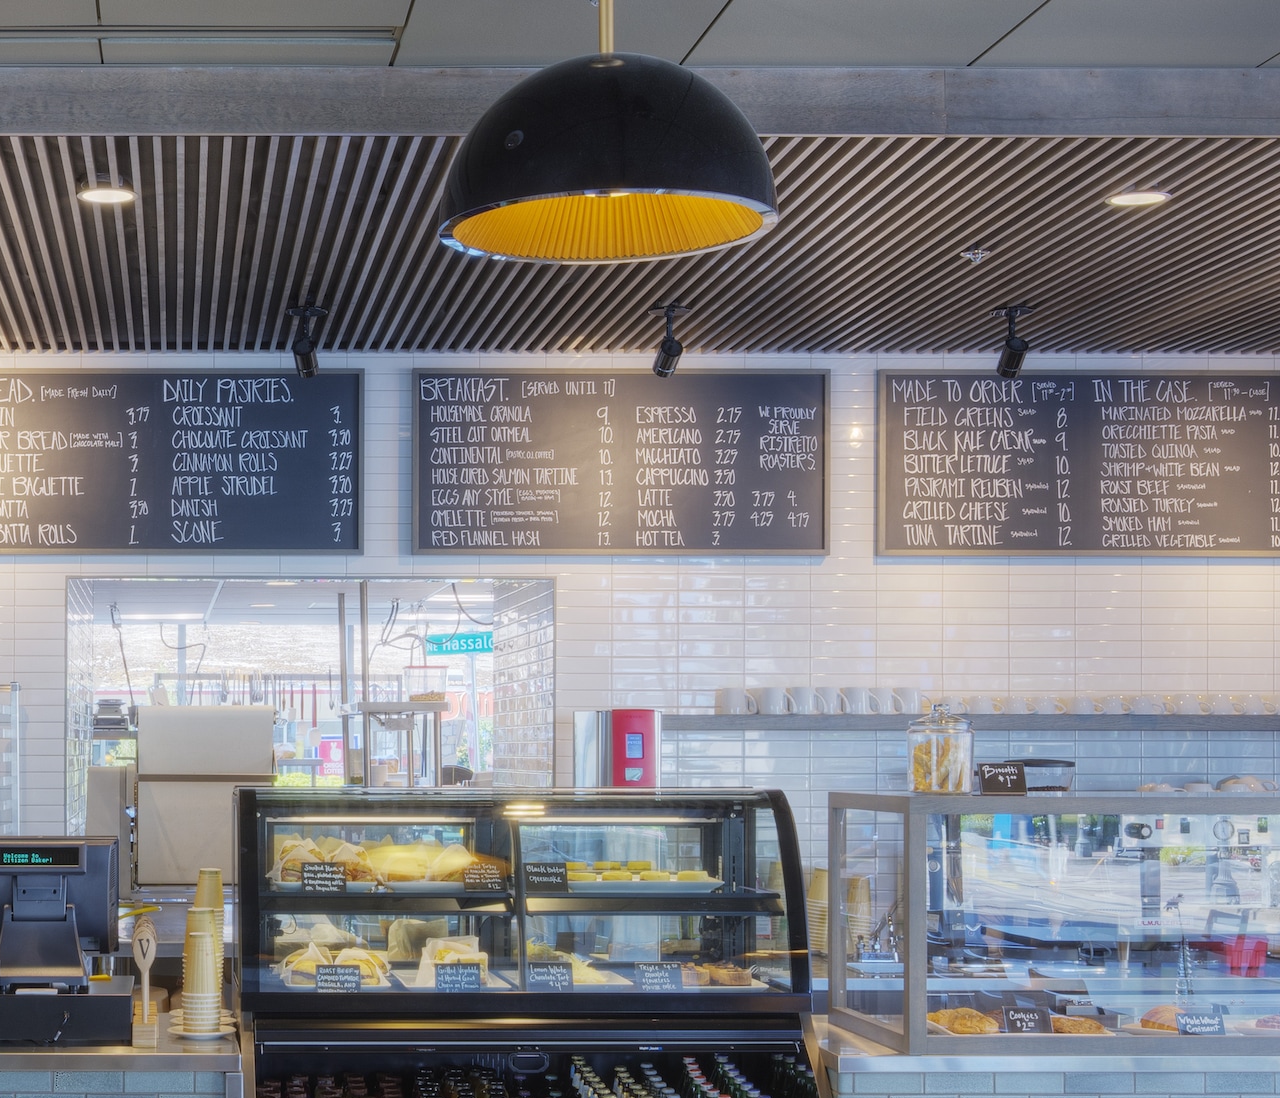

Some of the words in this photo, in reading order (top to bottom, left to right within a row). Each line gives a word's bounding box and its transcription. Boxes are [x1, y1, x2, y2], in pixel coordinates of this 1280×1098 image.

[163, 378, 207, 403] DAILY
[566, 381, 597, 395] UNTIL
[893, 379, 937, 404] MADE
[942, 380, 961, 402] TO
[1092, 379, 1113, 402] IN
[1118, 380, 1151, 403] THE
[172, 406, 243, 429] CROISSANT
[431, 405, 487, 423] HOUSEMADE
[490, 405, 532, 423] GRANOLA
[636, 406, 696, 424] ESPRESSO
[717, 407, 742, 423] 2.75
[759, 406, 770, 417] WE
[771, 407, 816, 423] PROUDLY
[904, 406, 947, 426] FIELD
[954, 407, 1013, 428] GREENS
[1102, 406, 1171, 421] MARINATED
[1177, 405, 1246, 421] MOZZARELLA
[430, 426, 465, 443] STEEL
[467, 426, 487, 442] CUT
[491, 426, 532, 443] OATMEAL
[637, 428, 702, 444] AMERICANO
[715, 429, 741, 444] 2.75
[768, 418, 800, 436] SERVE
[1102, 424, 1182, 440] ORECCHIETTE
[1186, 425, 1217, 440] PASTA
[18, 431, 68, 450] BREAD
[172, 428, 237, 450] CHOCOLATE
[241, 430, 308, 450] CROISSANT
[760, 434, 817, 454] RISTRETTO
[904, 430, 948, 451] BLACK
[953, 430, 987, 461] KALE
[990, 428, 1037, 453] CAESAR
[430, 446, 503, 465] CONTINENTAL
[636, 448, 701, 465] MACCHIATO
[715, 448, 738, 464] 3.25
[1102, 443, 1147, 459] TOASTED
[1152, 444, 1198, 459] QUINOA
[173, 452, 233, 473] CINNAMON
[239, 452, 277, 472] ROLLS
[904, 452, 957, 474] BUTTER
[961, 454, 1011, 474] LETTUCE
[1190, 462, 1220, 477] BEAN
[172, 475, 213, 496] APPLE
[221, 475, 277, 496] STRUDEL
[432, 468, 459, 485] HOUSE
[460, 468, 489, 485] CURED
[492, 468, 530, 485] SALMON
[533, 468, 579, 485] TARTINE
[636, 468, 709, 486] CAPPUCCINO
[714, 469, 735, 485] 3.50
[13, 477, 84, 496] BAGUETTE
[905, 477, 965, 498] PASTRAMI
[971, 478, 1023, 499] REUBEN
[1100, 480, 1132, 494] ROAST
[1137, 480, 1169, 495] BEEF
[432, 489, 459, 506] EGGS
[462, 489, 481, 506] ANY
[485, 488, 514, 506] STYLE
[638, 489, 673, 506] LATTE
[713, 490, 735, 507] 3.50
[752, 491, 775, 507] 3.75
[1101, 497, 1148, 513] ROASTED
[1152, 498, 1195, 513] TURKEY
[171, 499, 218, 517] DANISH
[903, 501, 955, 521] GRILLED
[959, 501, 1010, 521] CHEESE
[431, 509, 487, 527] OMELETTE
[638, 510, 677, 527] MOCHA
[712, 511, 735, 527] 3.75
[750, 511, 773, 527] 4.25
[787, 512, 809, 527] 4.75
[1102, 516, 1143, 532] SMOKED
[1148, 516, 1171, 532] HAM
[38, 524, 77, 546] ROLLS
[171, 520, 224, 543] SCONE
[432, 530, 458, 546] RED
[461, 530, 508, 546] FLANNEL
[512, 531, 540, 546] HASH
[636, 531, 659, 546] HOT
[661, 530, 685, 546] TEA
[903, 524, 937, 546] TUNA
[944, 524, 1003, 546] TARTINE
[1102, 534, 1151, 547] GRILLED
[1155, 534, 1216, 548] VEGETABLE
[982, 764, 1018, 778] Biscotti
[526, 864, 546, 873] Black
[137, 938, 150, 960] V
[530, 964, 548, 973] Lemon
[548, 965, 568, 974] White
[1009, 1010, 1039, 1021] Cookies
[1178, 1016, 1200, 1025] Whole
[1200, 1016, 1220, 1026] Wheat
